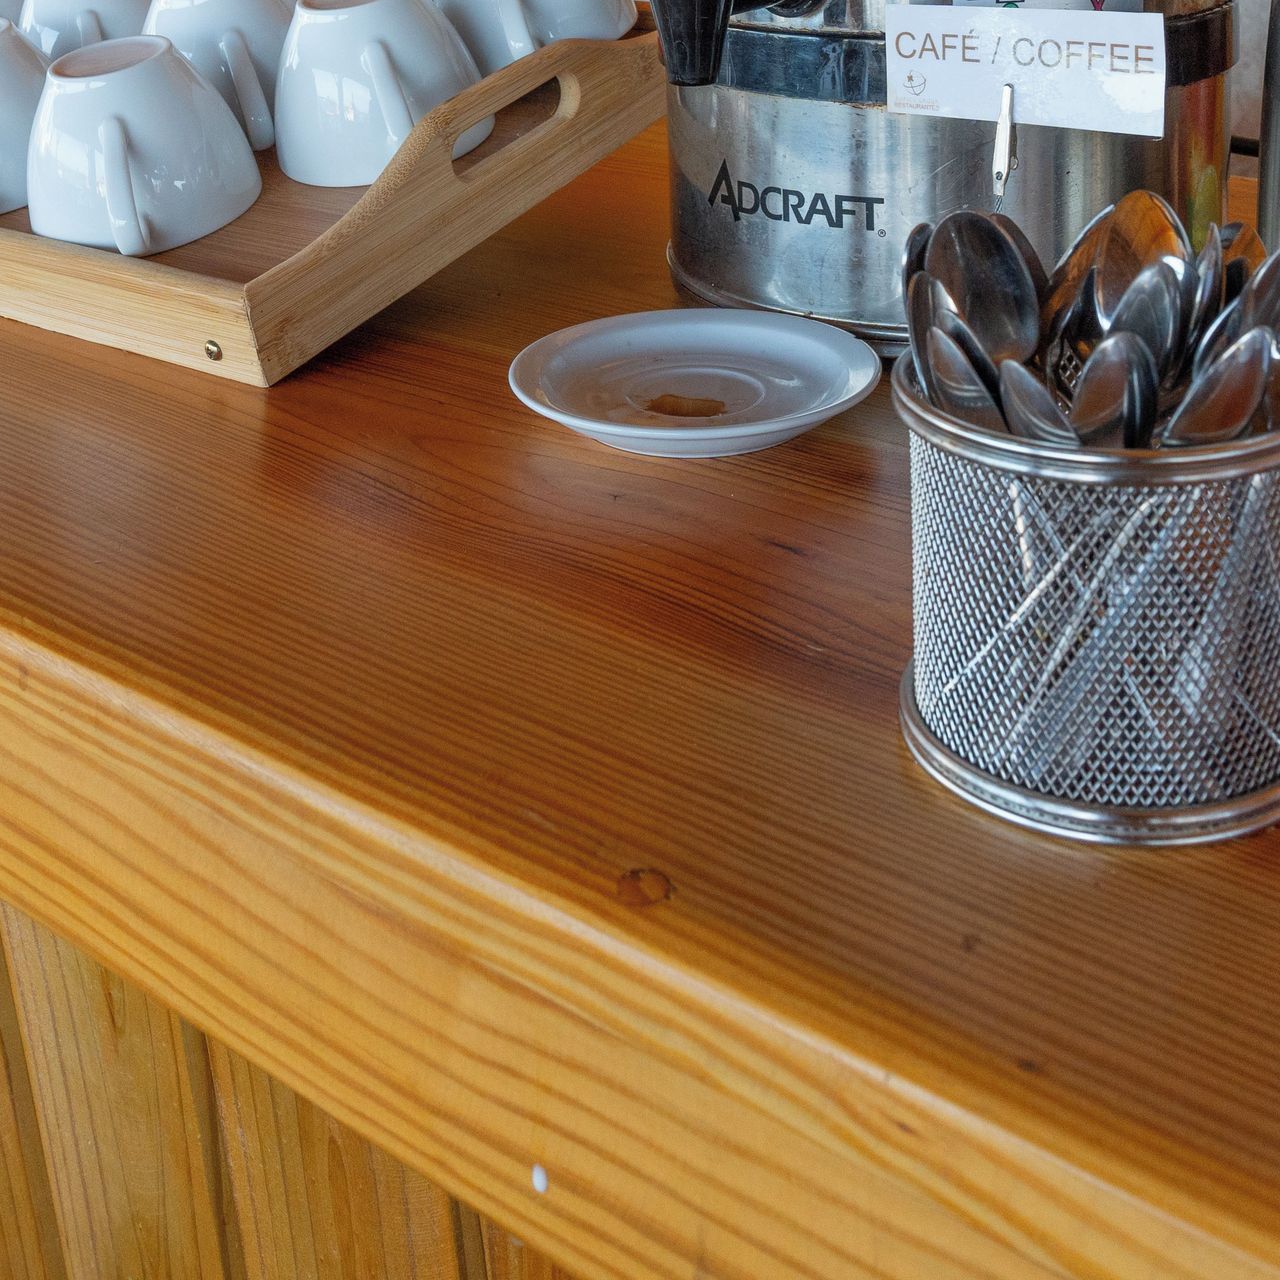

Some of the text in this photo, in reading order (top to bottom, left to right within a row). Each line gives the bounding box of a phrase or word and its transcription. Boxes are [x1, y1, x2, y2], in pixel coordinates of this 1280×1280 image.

[895, 29, 1155, 74] CAFÉ / COFFEE
[707, 158, 885, 232] ADCRAFT
